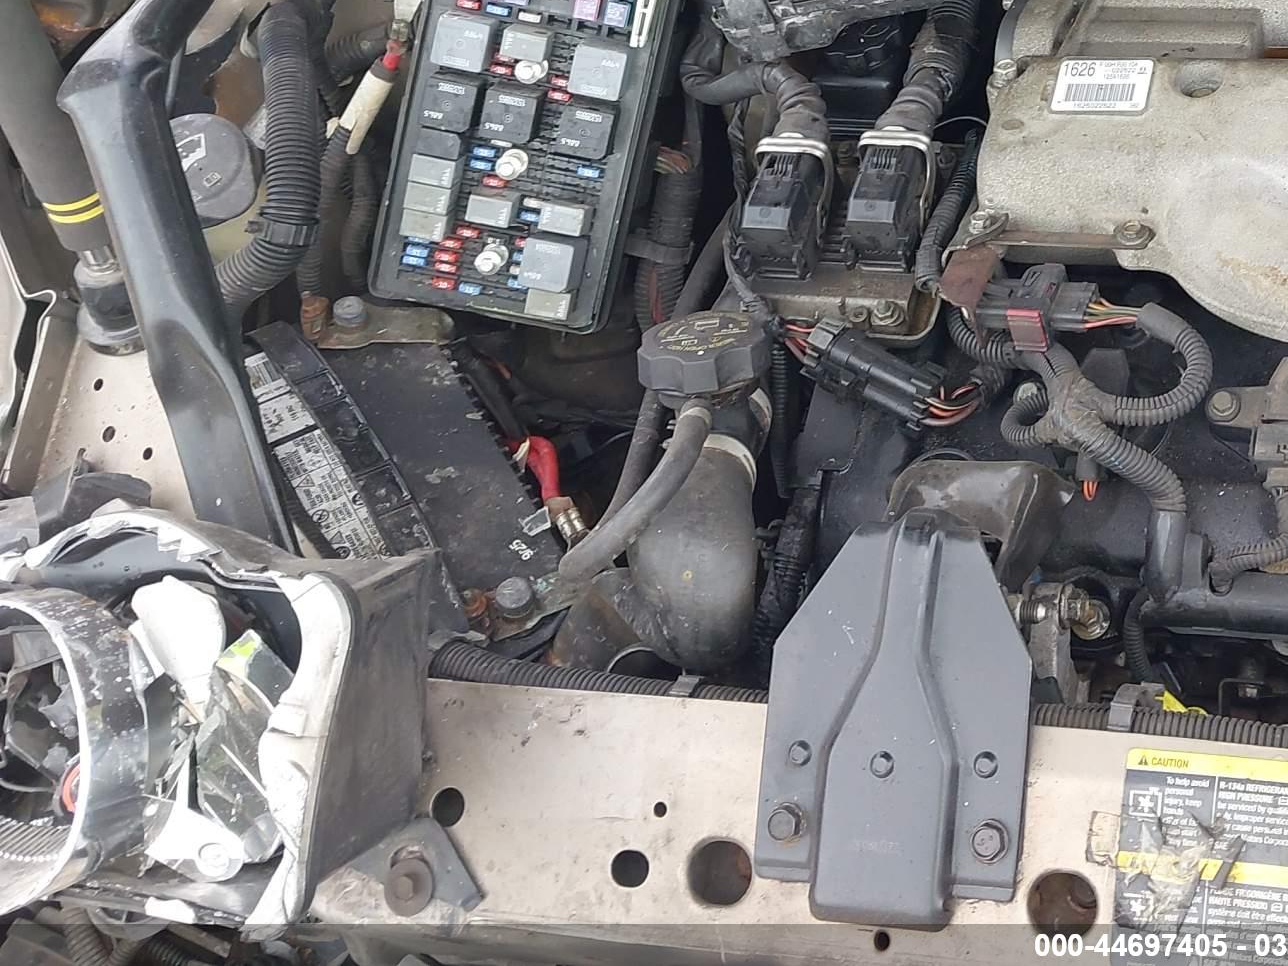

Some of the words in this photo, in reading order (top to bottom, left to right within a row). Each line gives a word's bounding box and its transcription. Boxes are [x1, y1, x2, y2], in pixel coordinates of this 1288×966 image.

[1063, 62, 1096, 76] 1626
[1151, 758, 1189, 769] CAUTION
[1166, 776, 1176, 785] To
